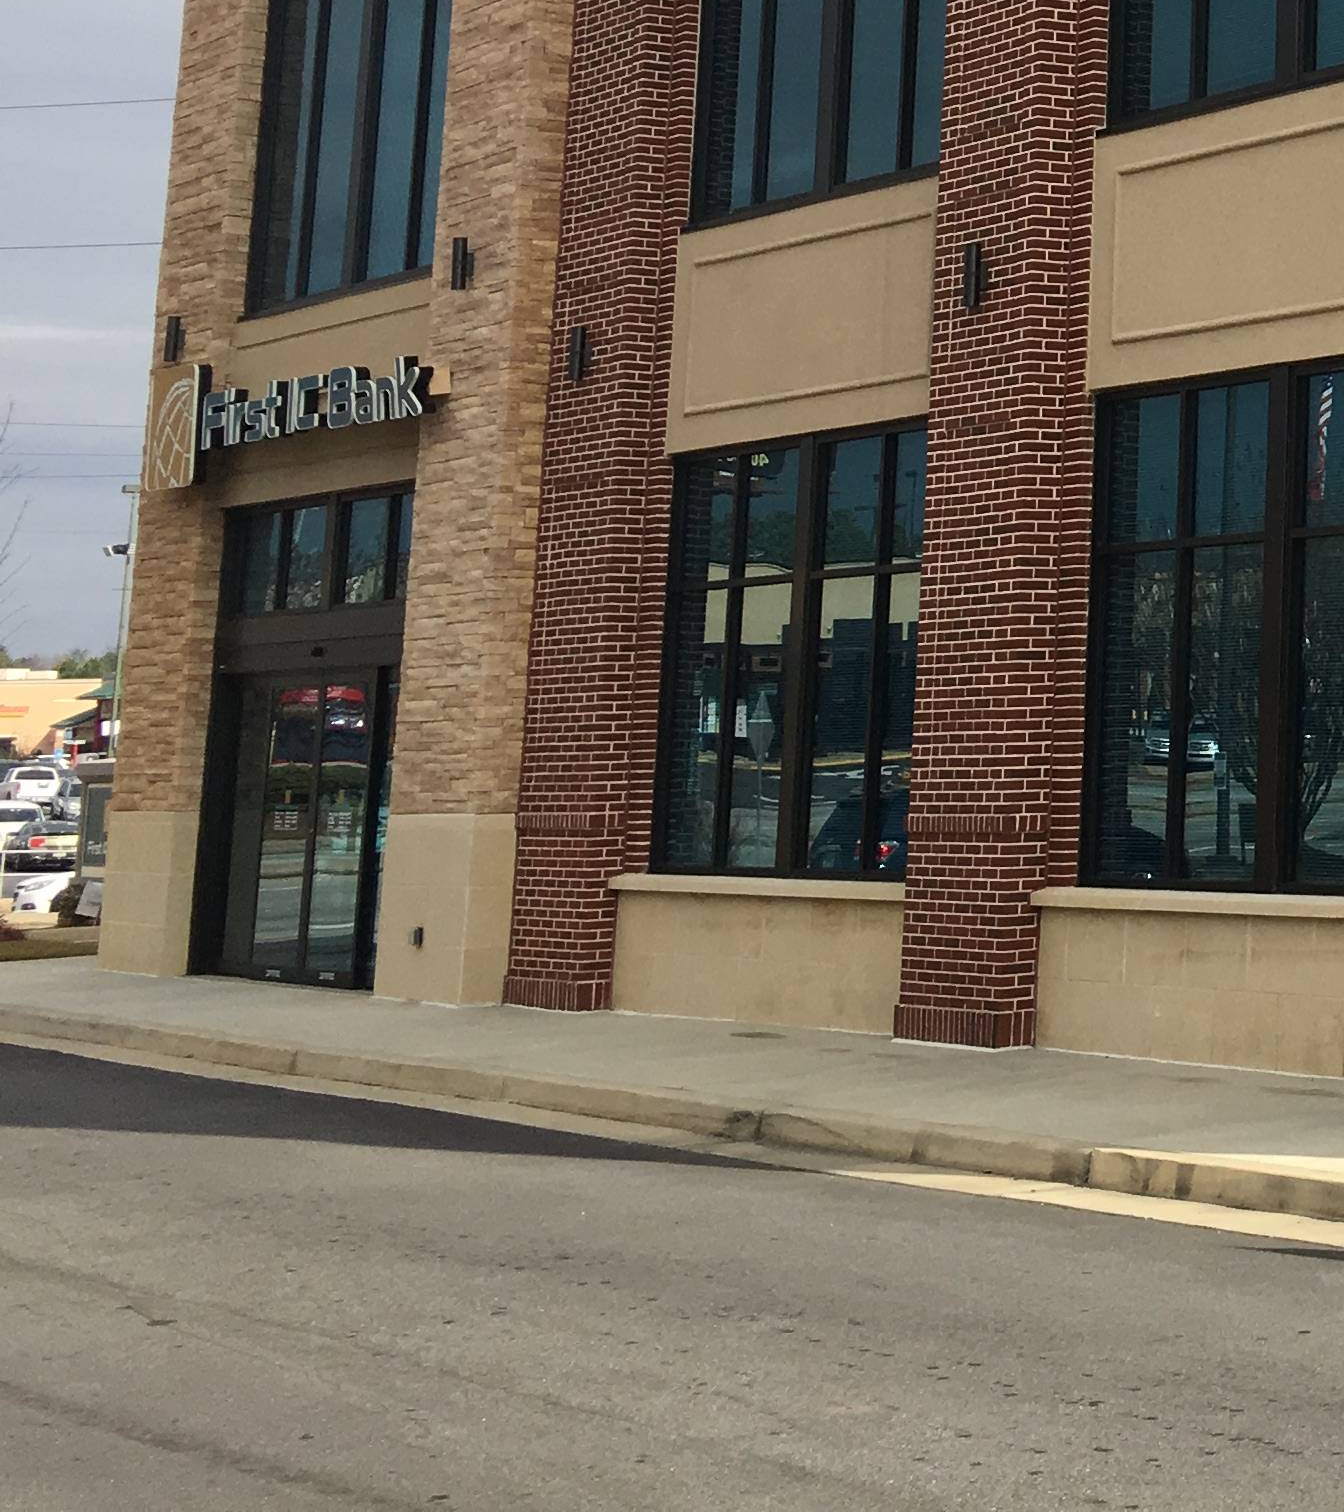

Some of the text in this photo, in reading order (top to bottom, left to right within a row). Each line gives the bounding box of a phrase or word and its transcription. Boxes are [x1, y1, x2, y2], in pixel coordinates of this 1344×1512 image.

[200, 355, 423, 451] First IC Bank
